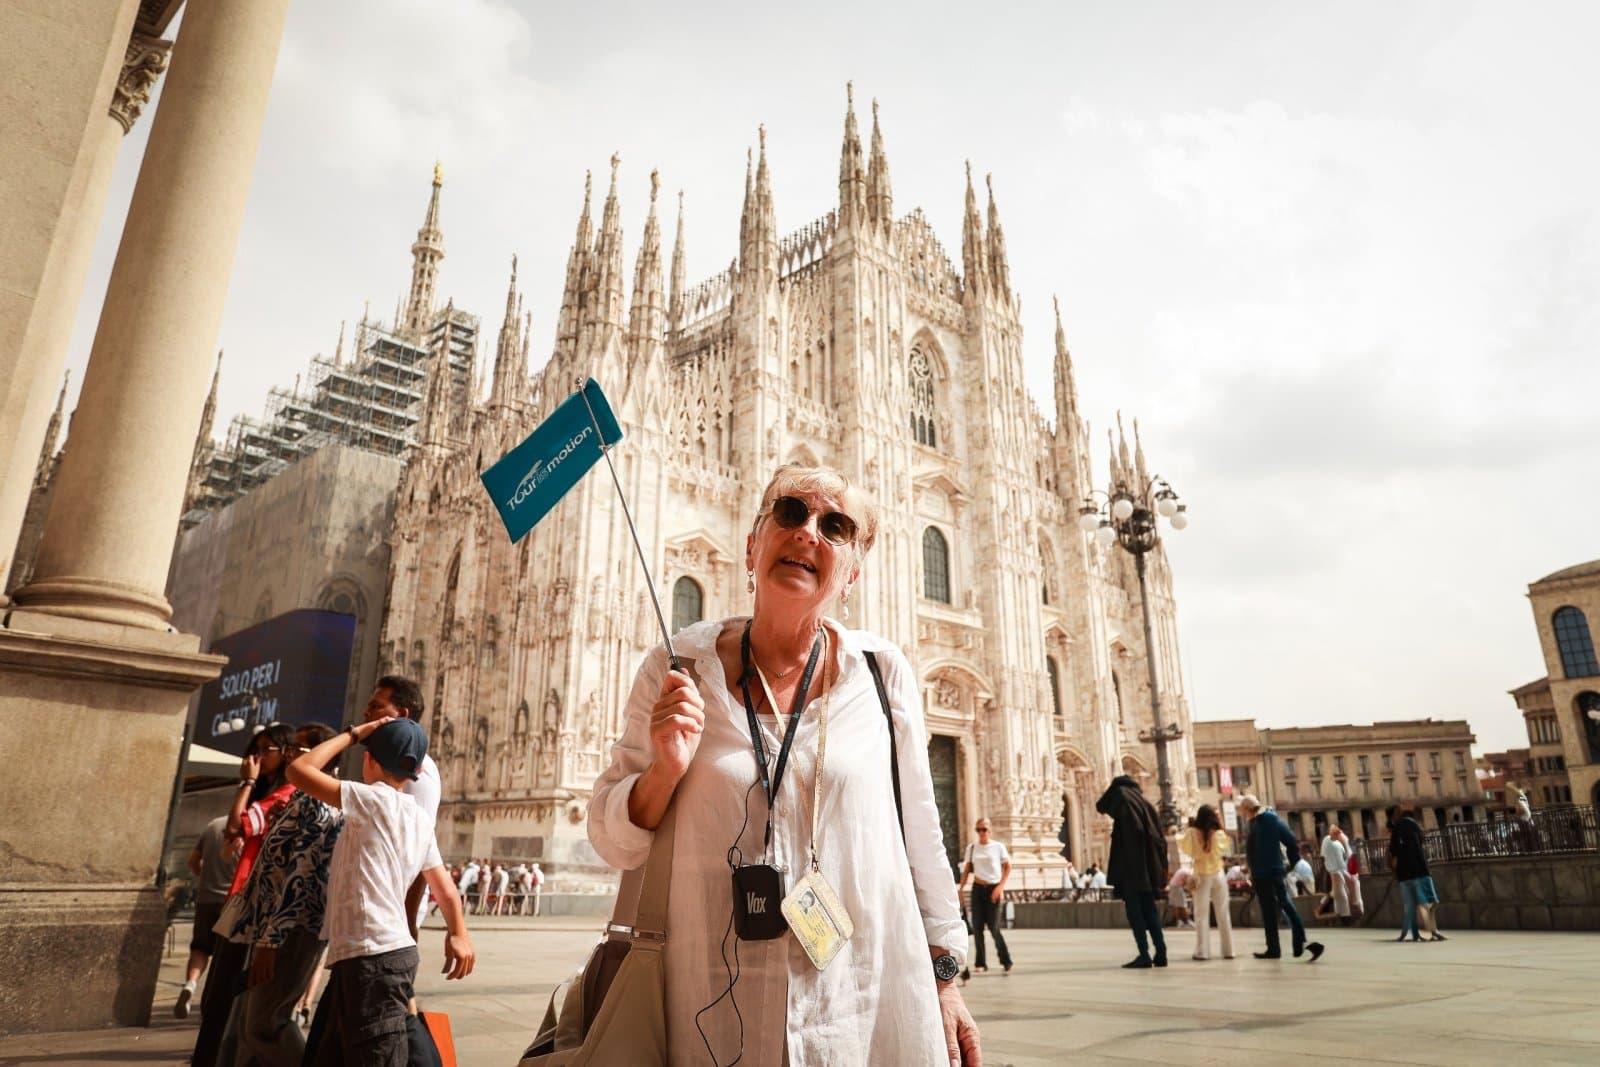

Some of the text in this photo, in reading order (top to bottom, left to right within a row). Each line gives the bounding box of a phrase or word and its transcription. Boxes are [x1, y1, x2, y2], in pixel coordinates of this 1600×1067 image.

[219, 659, 281, 700] SOLO PER I
[746, 892, 767, 914] Vox
